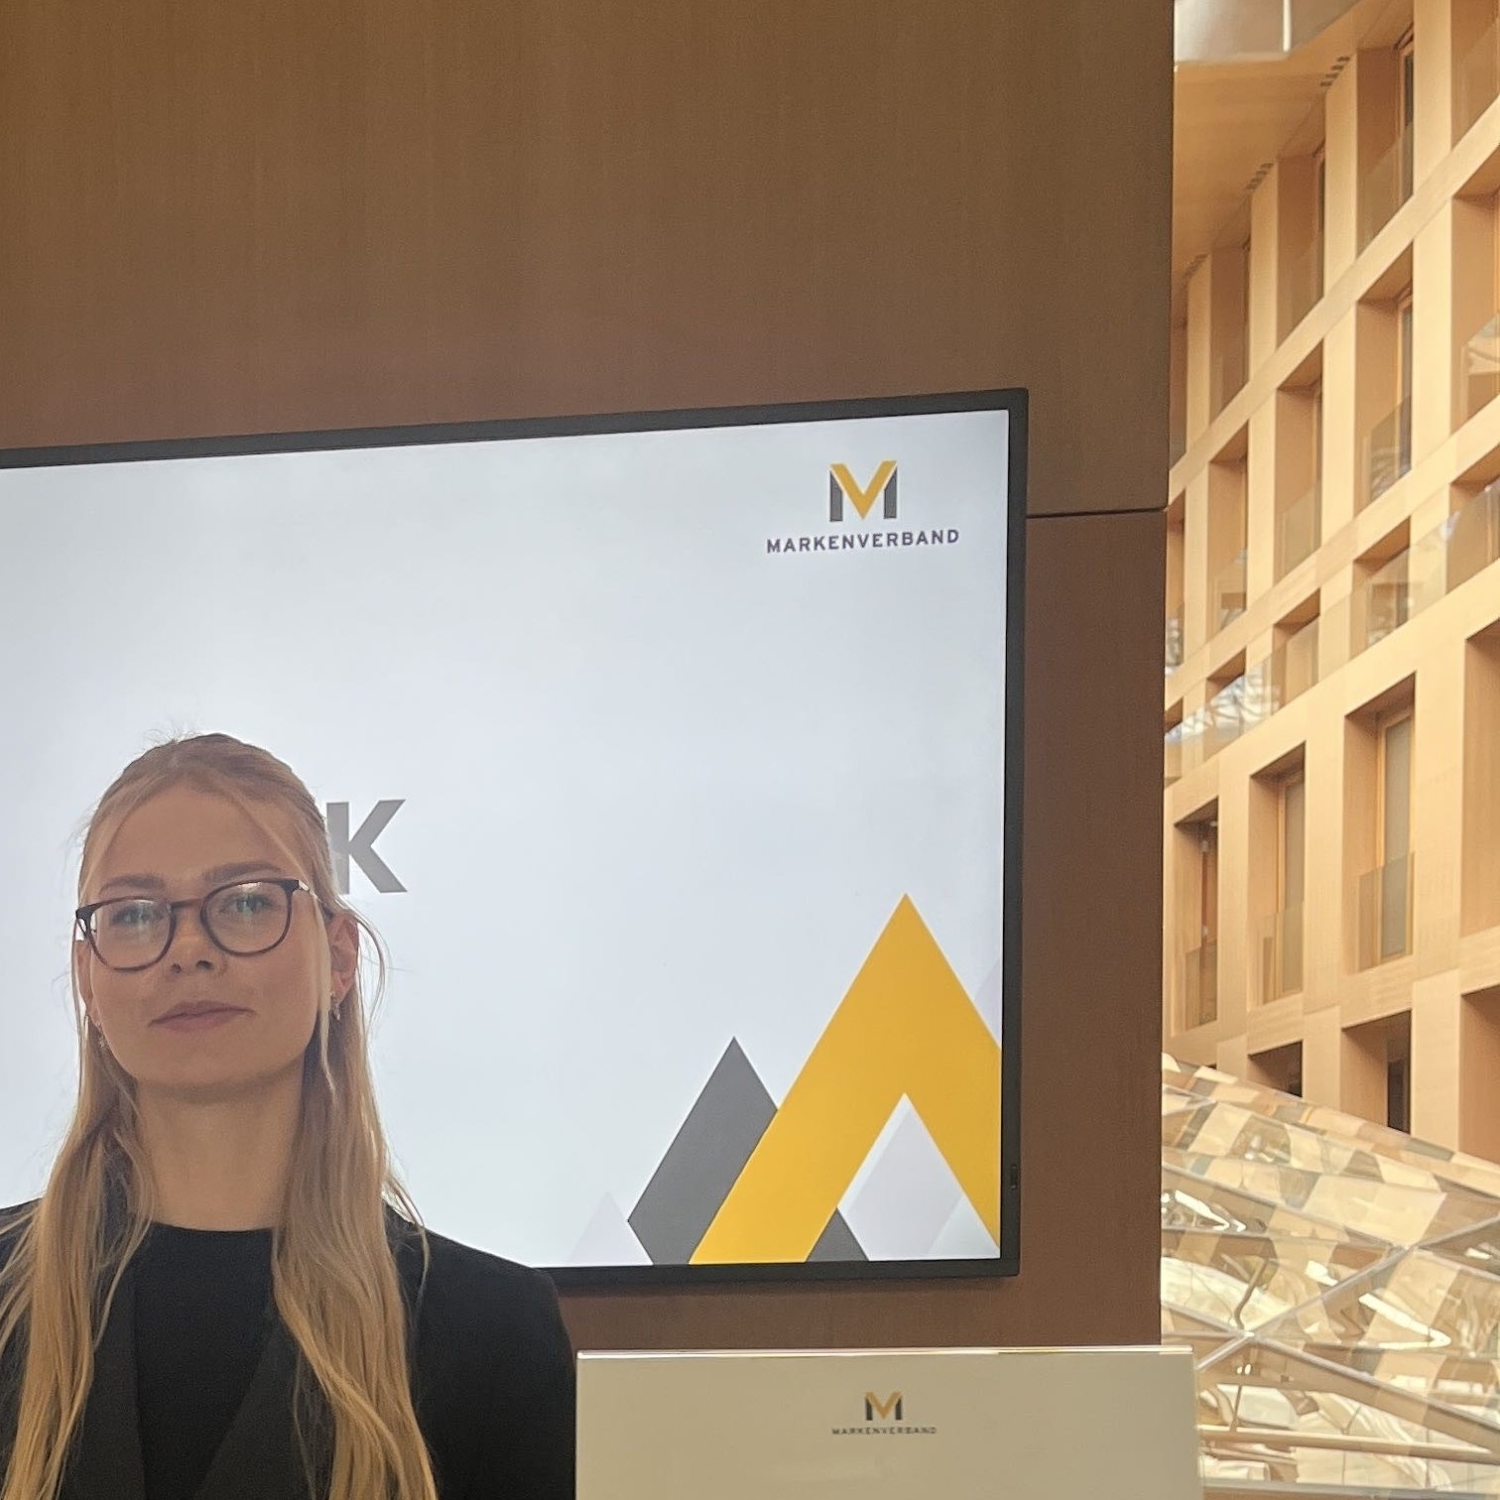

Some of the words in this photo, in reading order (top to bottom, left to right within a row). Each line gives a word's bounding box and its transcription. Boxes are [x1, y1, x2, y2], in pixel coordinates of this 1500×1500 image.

[766, 528, 960, 554] MARKENVERBAND
[326, 799, 408, 895] K
[831, 1426, 938, 1435] MARKENVERBAND
